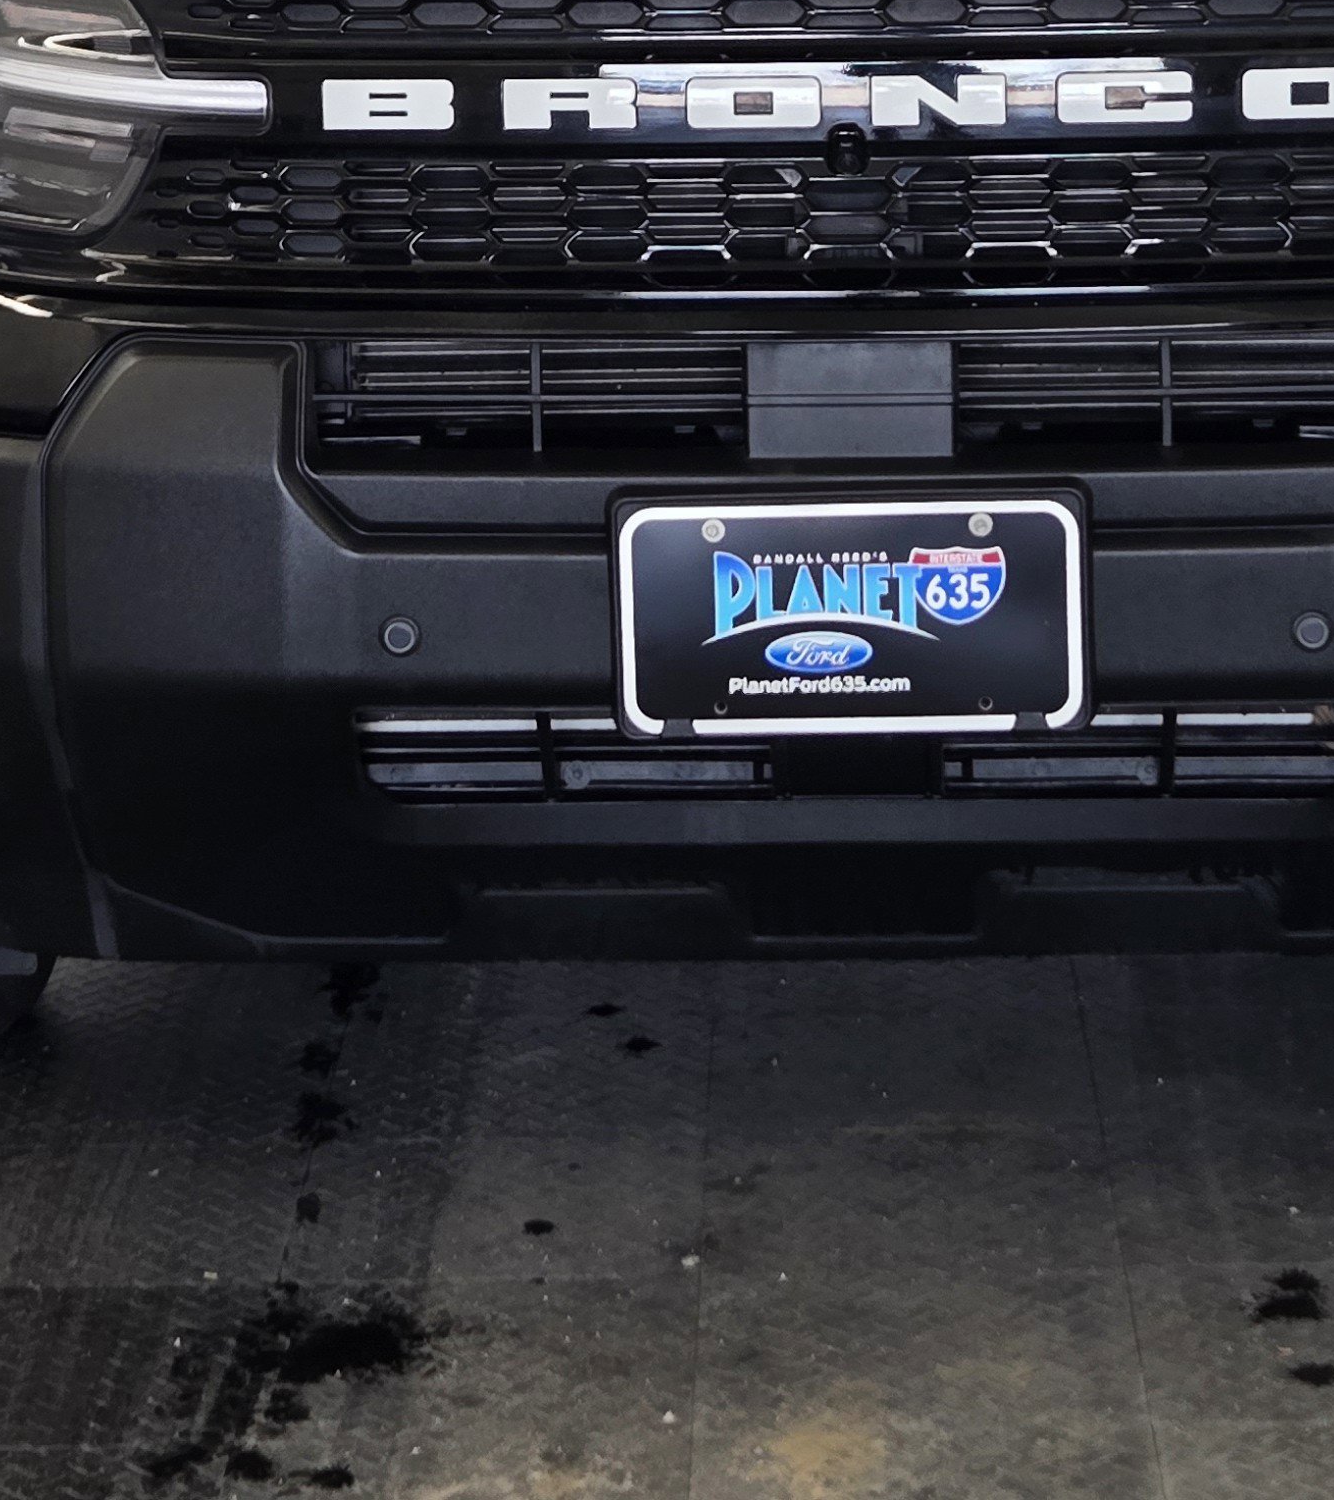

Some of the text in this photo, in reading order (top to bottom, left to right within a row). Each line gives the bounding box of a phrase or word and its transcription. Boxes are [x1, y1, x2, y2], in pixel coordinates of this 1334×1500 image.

[713, 551, 923, 636] PLANET
[925, 573, 990, 610] 635
[785, 638, 850, 666] Ford
[728, 675, 912, 695] PlanetFord635.com
